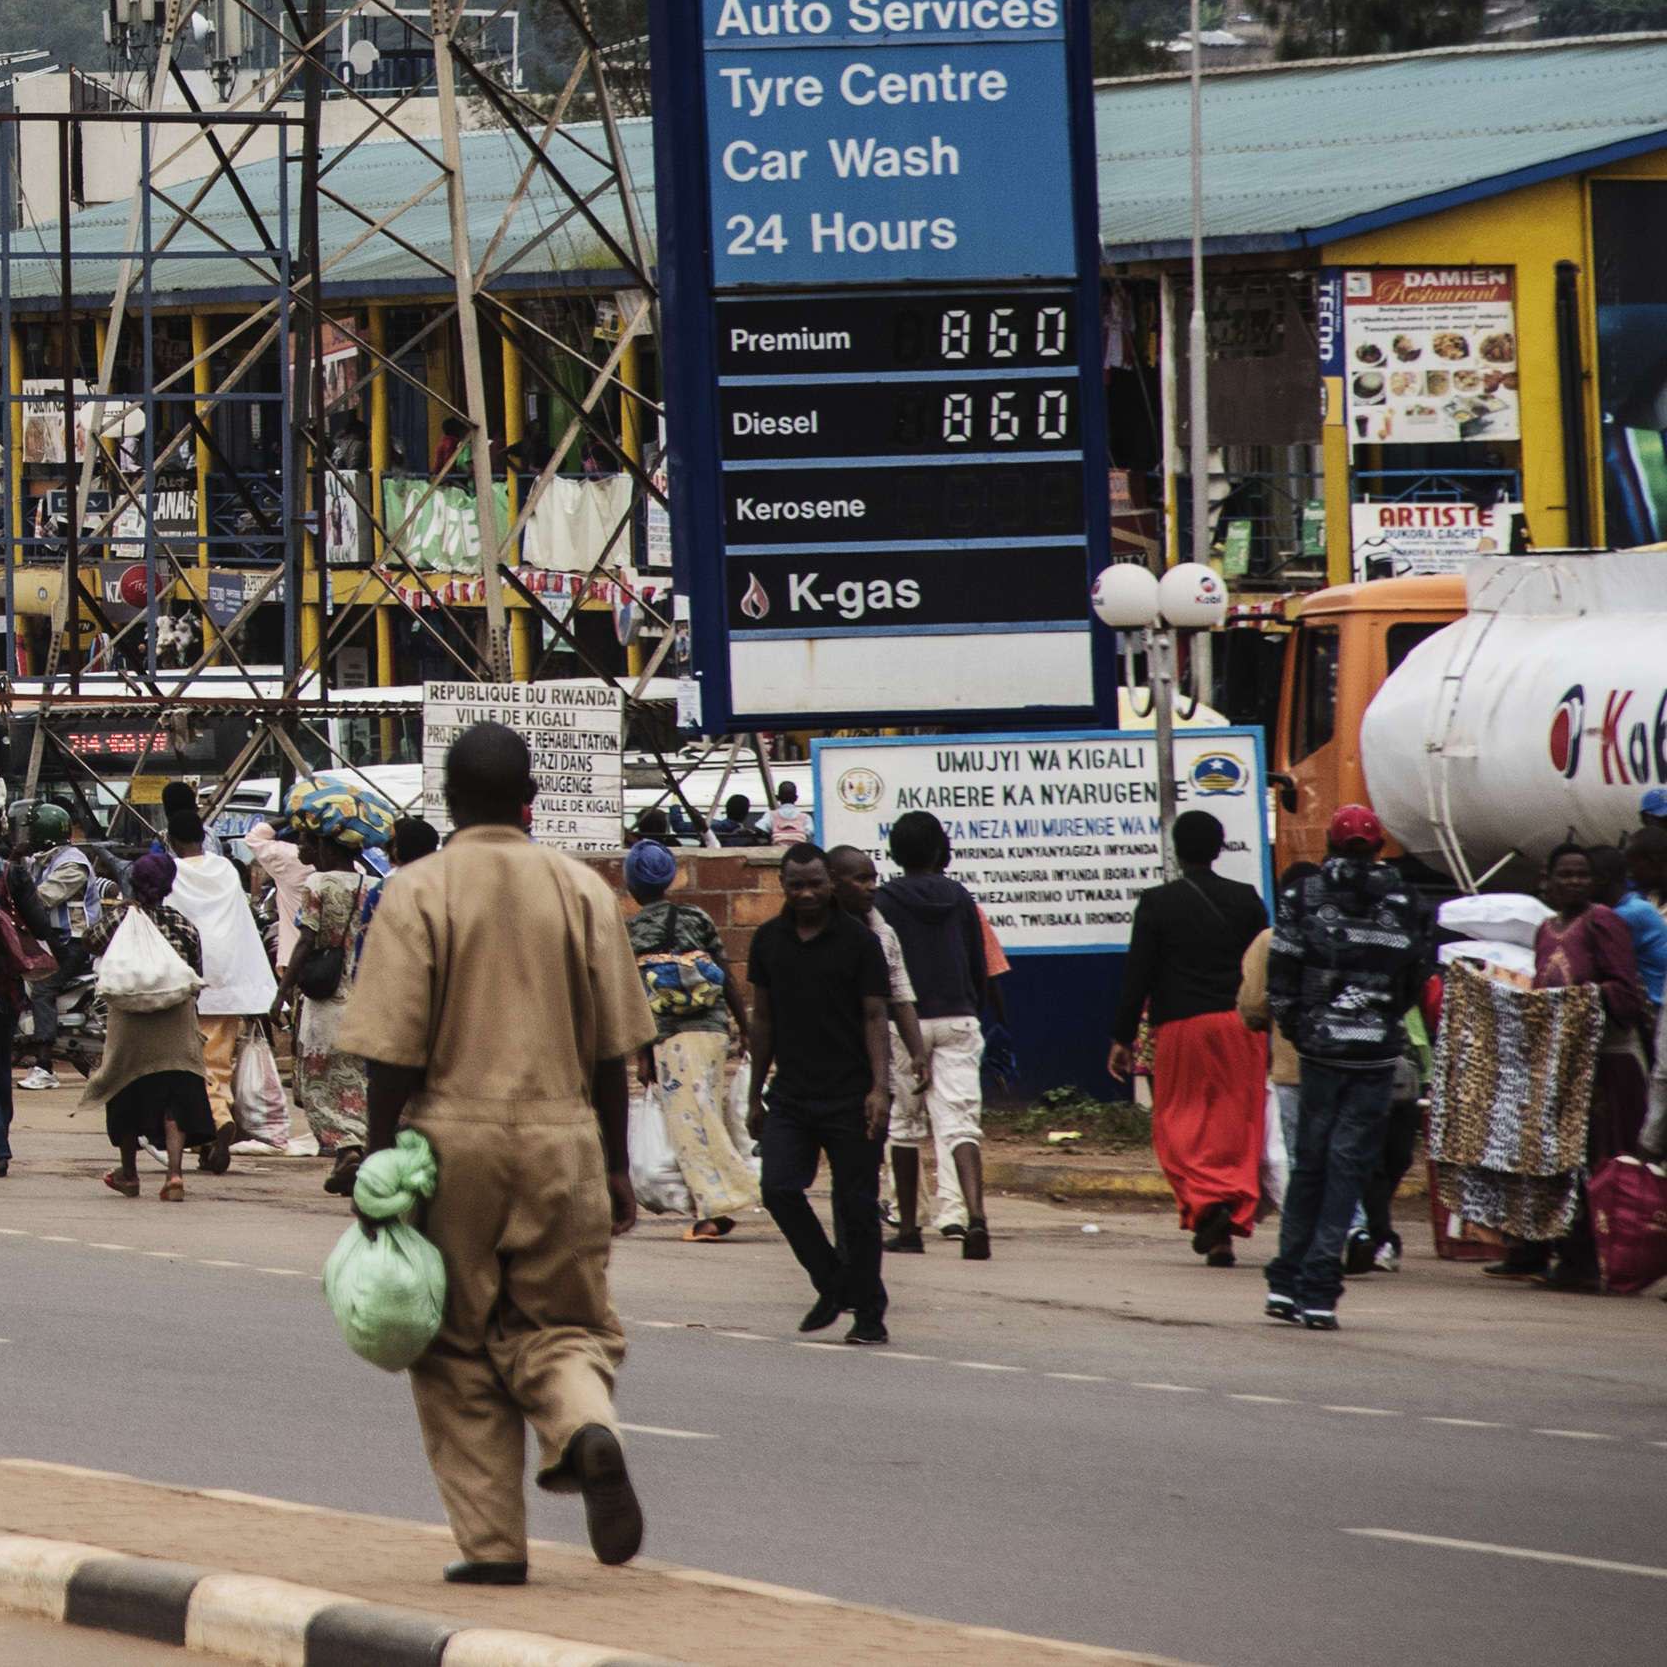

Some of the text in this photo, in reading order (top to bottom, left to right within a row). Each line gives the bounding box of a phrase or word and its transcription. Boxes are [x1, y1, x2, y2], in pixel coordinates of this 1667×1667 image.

[719, 62, 1008, 117] Tyre Centre
[722, 135, 960, 182] Car Wash
[725, 212, 957, 255] 24 Hours
[1404, 271, 1507, 287] DAMIEN
[730, 307, 1066, 359] Premium 860
[732, 390, 1067, 442] Diesel 860
[735, 496, 866, 521] Kerosene
[1379, 506, 1495, 527] ARTISTE
[788, 573, 921, 620] K-gas
[525, 687, 546, 704] DU
[551, 688, 617, 707] RWANDA
[456, 708, 577, 727] VILLE DE KIGALI
[535, 732, 618, 751] REHABILITATION
[531, 752, 593, 773] PAZI DANS
[937, 747, 1145, 773] UMUJYI WA KIGALI
[897, 780, 1188, 809] AKARERE KA NYARUGENE
[540, 798, 620, 814] VILLE DE KIGALI
[969, 819, 1011, 839] NEZA
[1015, 818, 1040, 838] MU
[1042, 816, 1115, 838] MURENGE
[1117, 815, 1145, 835] WA
[1008, 844, 1101, 859] KUNYANYAGIZA
[1104, 843, 1158, 856] IMYANDA
[982, 869, 1049, 884] TUVANGURA
[1066, 887, 1122, 902] UTWARA
[1021, 912, 1082, 927] TWUBAKA
